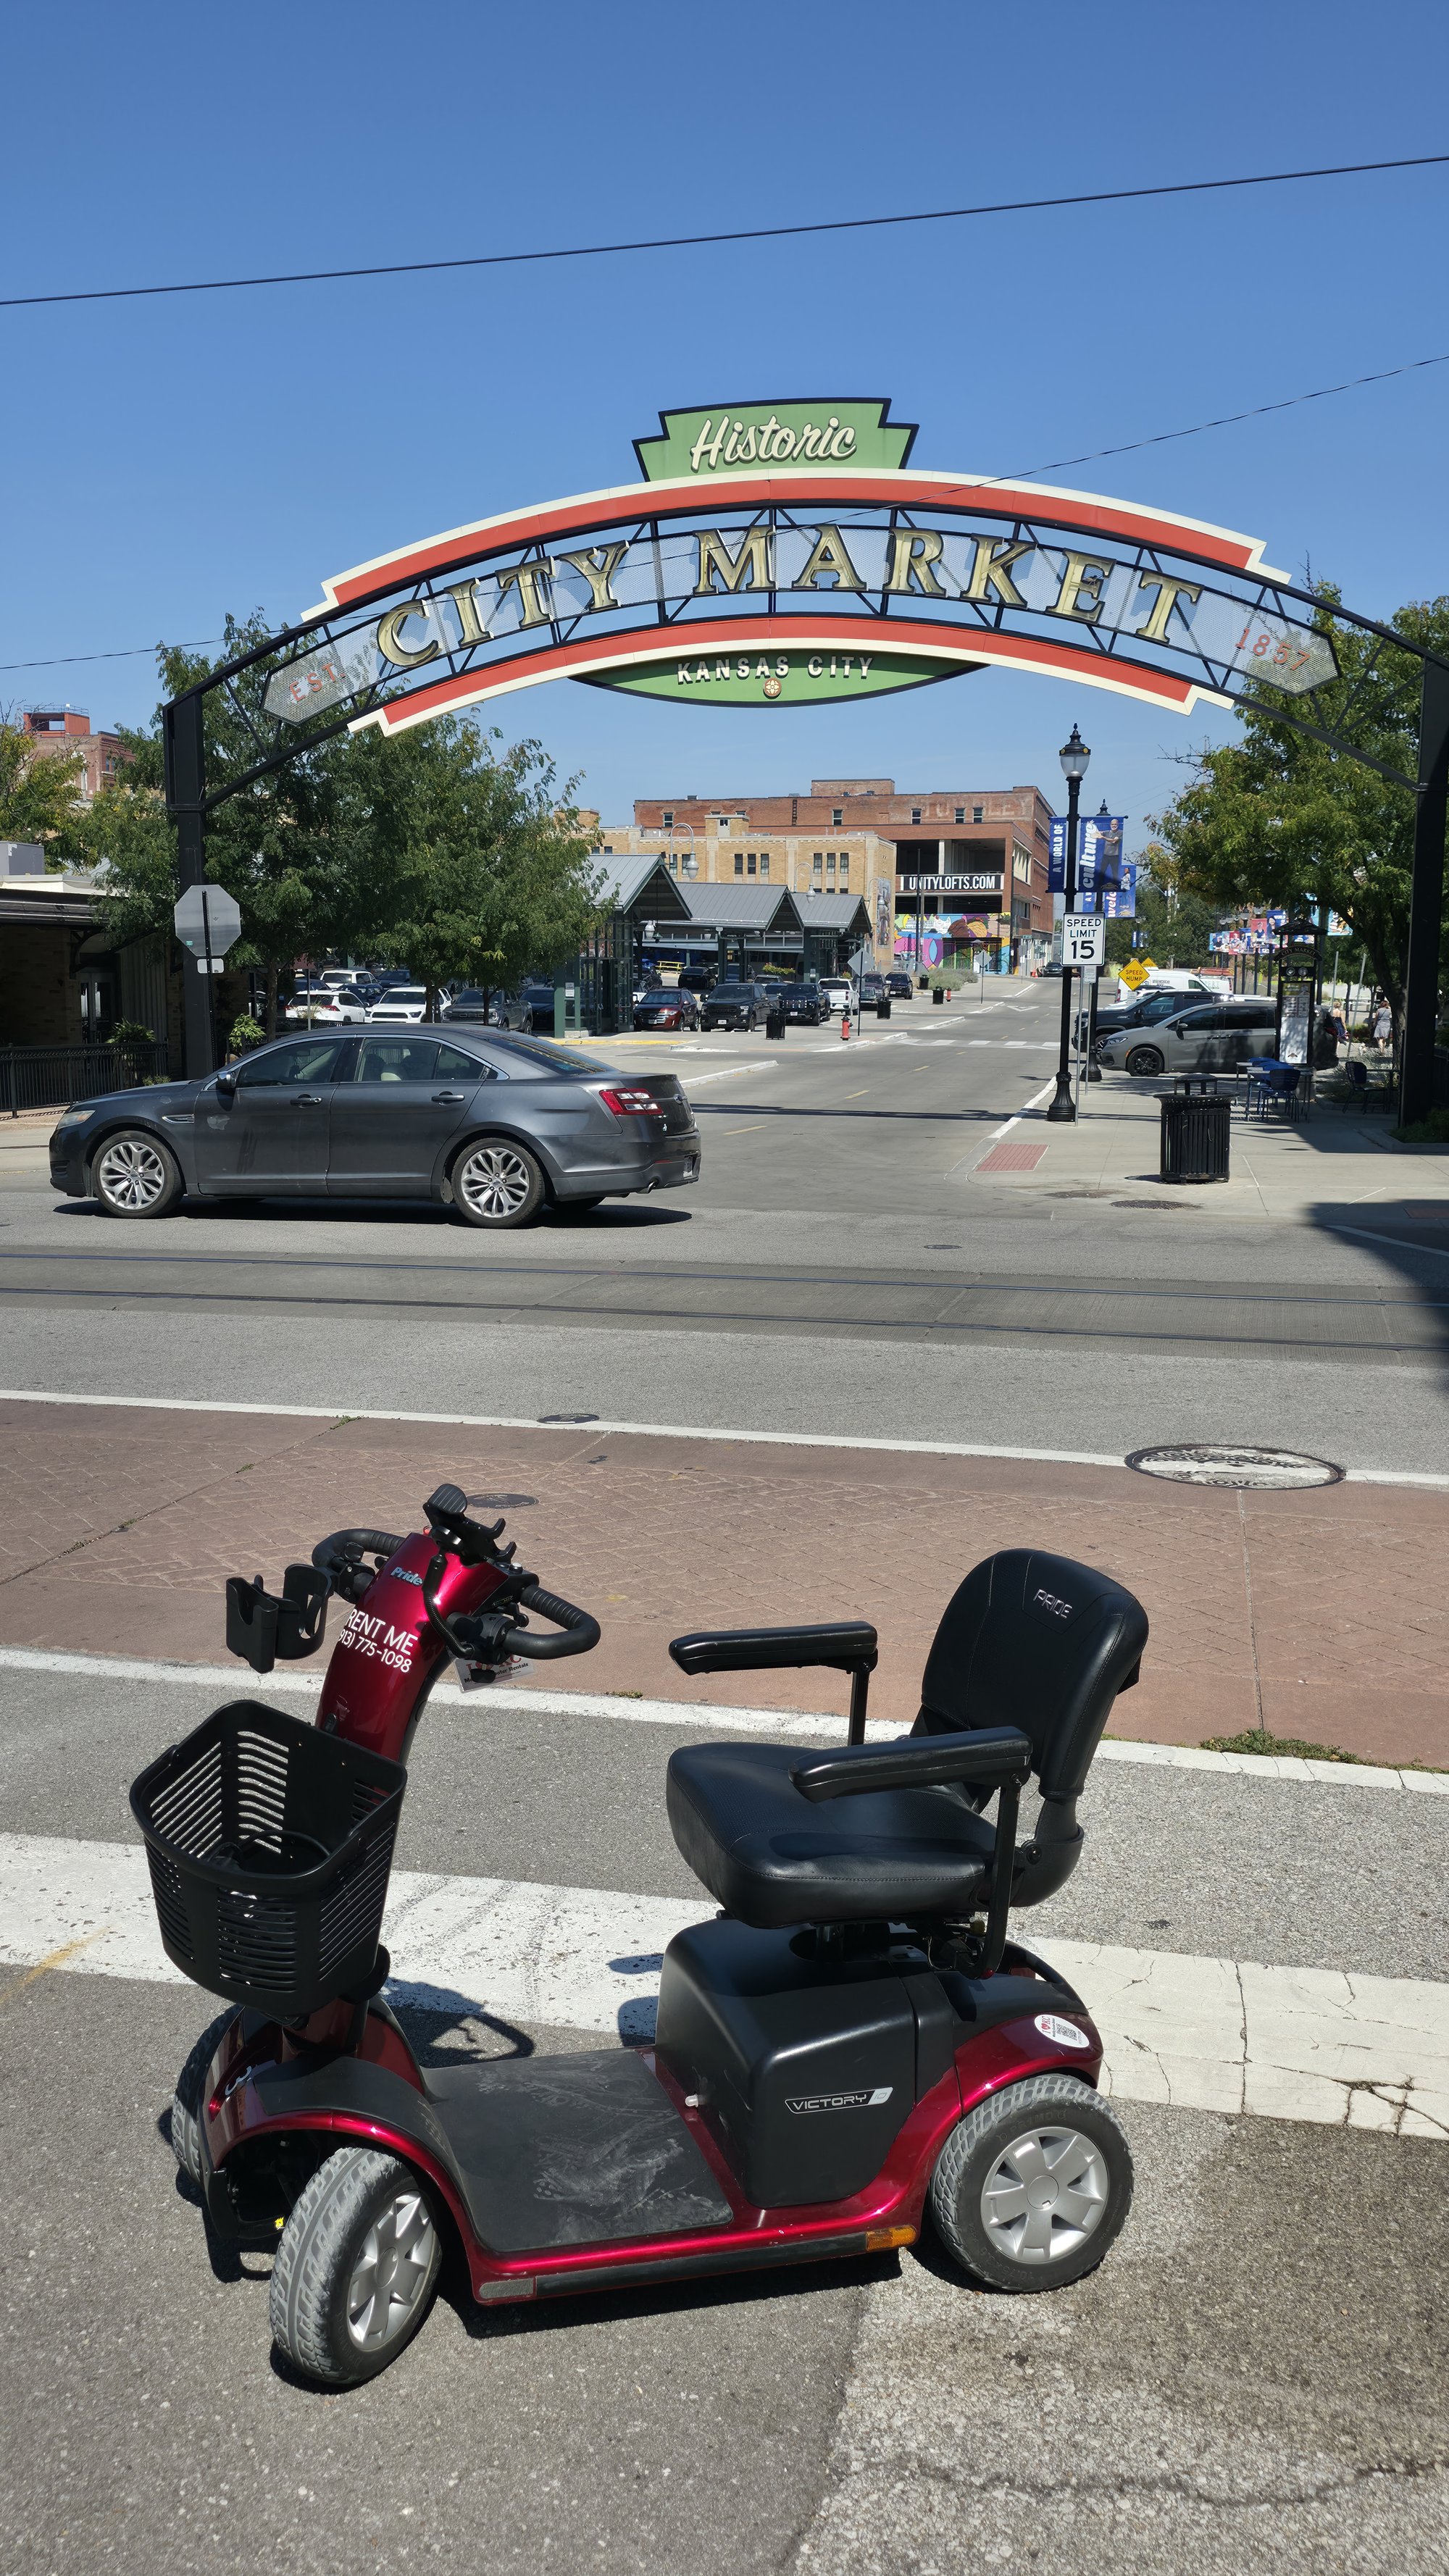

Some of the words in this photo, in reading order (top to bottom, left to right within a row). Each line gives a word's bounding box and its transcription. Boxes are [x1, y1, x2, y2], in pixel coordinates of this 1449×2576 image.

[690, 415, 857, 472] Historic
[377, 540, 630, 668] CITY
[692, 523, 1203, 646] MARKET
[1235, 627, 1311, 672] 1857
[290, 662, 346, 702] EST.
[677, 656, 789, 685] KANSAS
[808, 656, 872, 679] CITY
[1054, 824, 1064, 834] OF
[1053, 837, 1063, 864] WORLD
[1080, 823, 1098, 889] culture
[909, 875, 995, 890] UNITYLOFTS.COM
[1066, 919, 1102, 927] SPEED
[1069, 929, 1098, 938] LIMIT
[1071, 940, 1095, 959] 15
[391, 1566, 423, 1586] Pride
[1033, 1589, 1072, 1618] PRIDE
[345, 1608, 386, 1639] RENT
[383, 1625, 419, 1656] ME
[355, 1636, 412, 1673] 775-1098
[509, 1662, 529, 1672] Rentals
[793, 2094, 867, 2110] VICTORY
